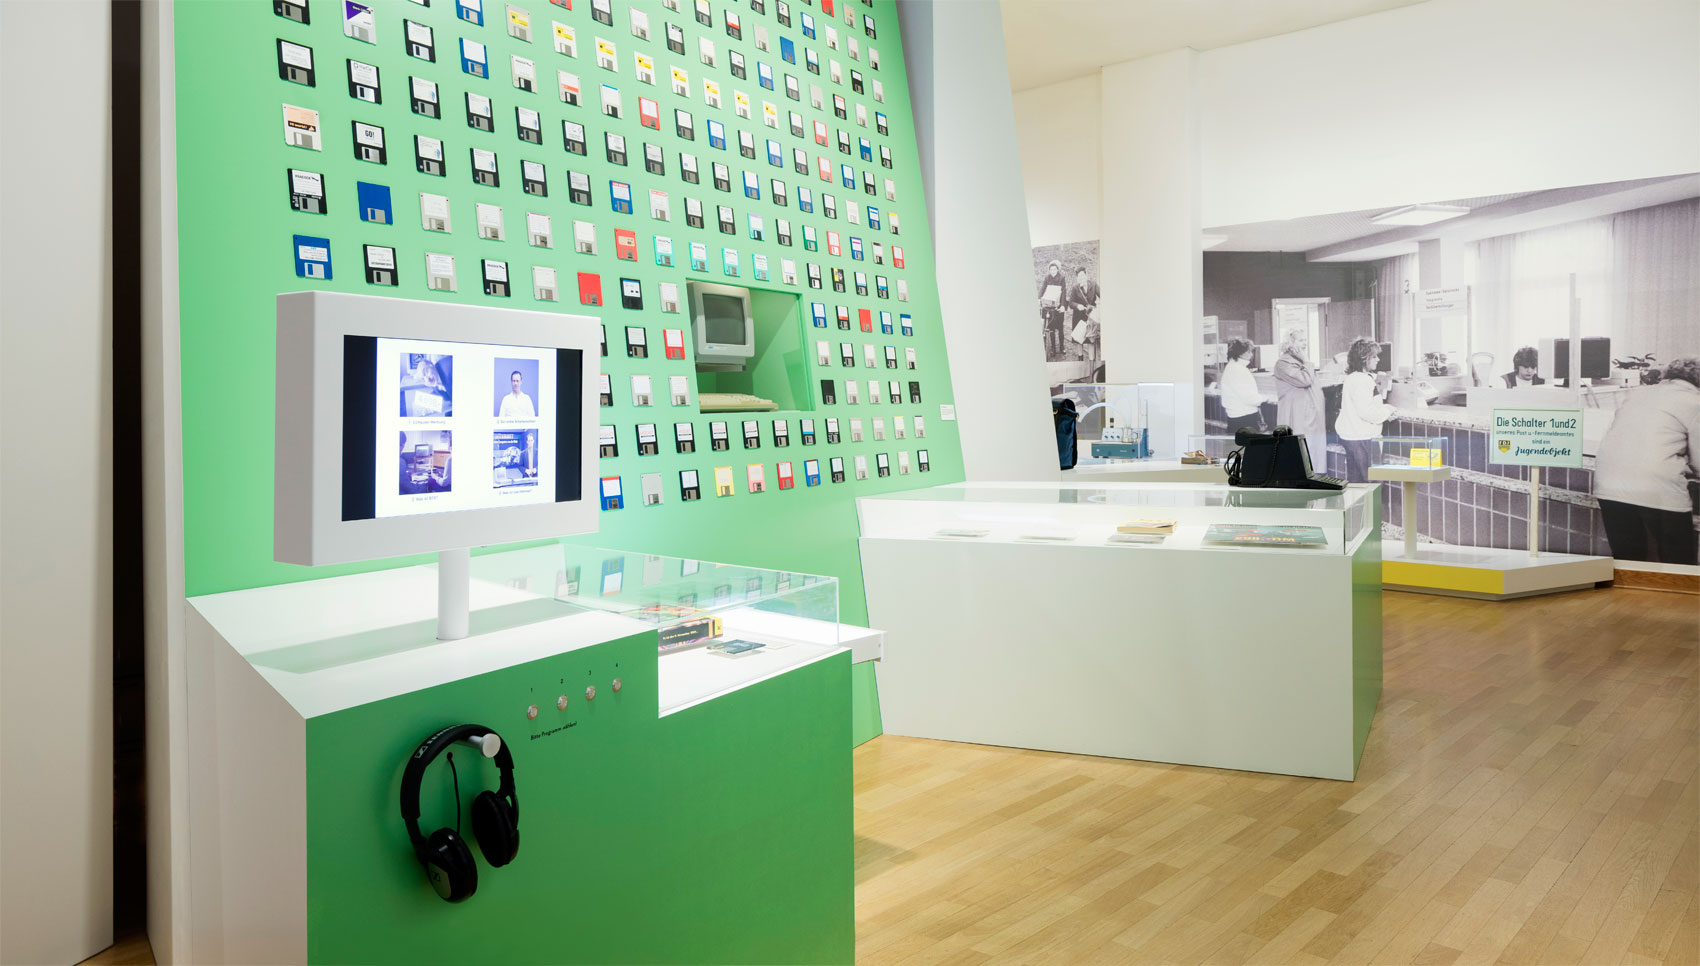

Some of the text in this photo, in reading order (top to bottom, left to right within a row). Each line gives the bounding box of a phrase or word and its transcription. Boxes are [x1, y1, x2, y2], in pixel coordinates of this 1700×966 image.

[1497, 417, 1509, 427] Die
[1512, 417, 1547, 427] Schalter
[1515, 446, 1571, 457] Jugendobjekt
[541, 727, 562, 737] Programm
